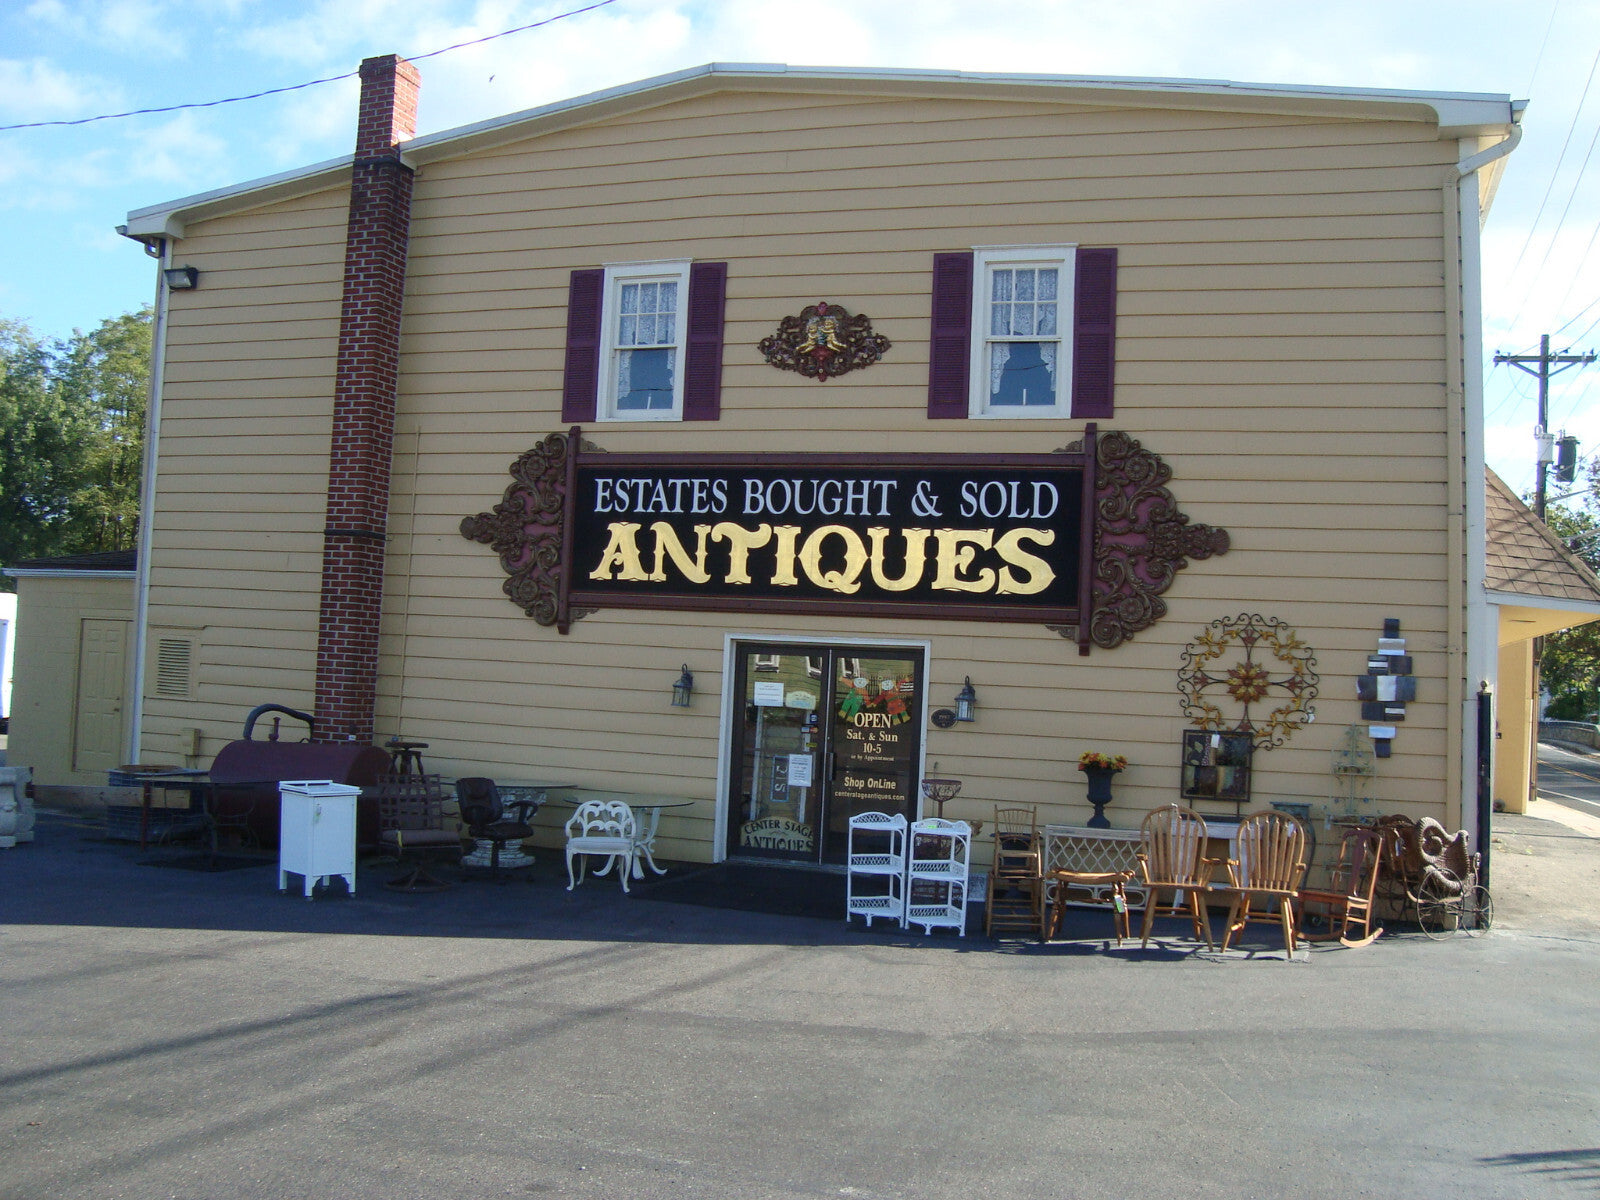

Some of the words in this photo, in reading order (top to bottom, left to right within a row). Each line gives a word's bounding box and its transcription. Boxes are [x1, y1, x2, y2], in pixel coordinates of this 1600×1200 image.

[594, 478, 728, 513] ESTATES
[743, 479, 898, 515] BOUGHT
[911, 480, 943, 517] &
[960, 481, 1059, 518] SOLD
[589, 521, 1056, 594] ANTIQUES
[854, 712, 892, 728] OPEN
[847, 729, 865, 740] Sat.
[869, 732, 876, 741] &
[879, 731, 898, 742] Sun
[863, 742, 882, 754] 10-5
[844, 776, 865, 789] Shop
[867, 778, 896, 789] OnLine
[744, 820, 780, 834] CENTER
